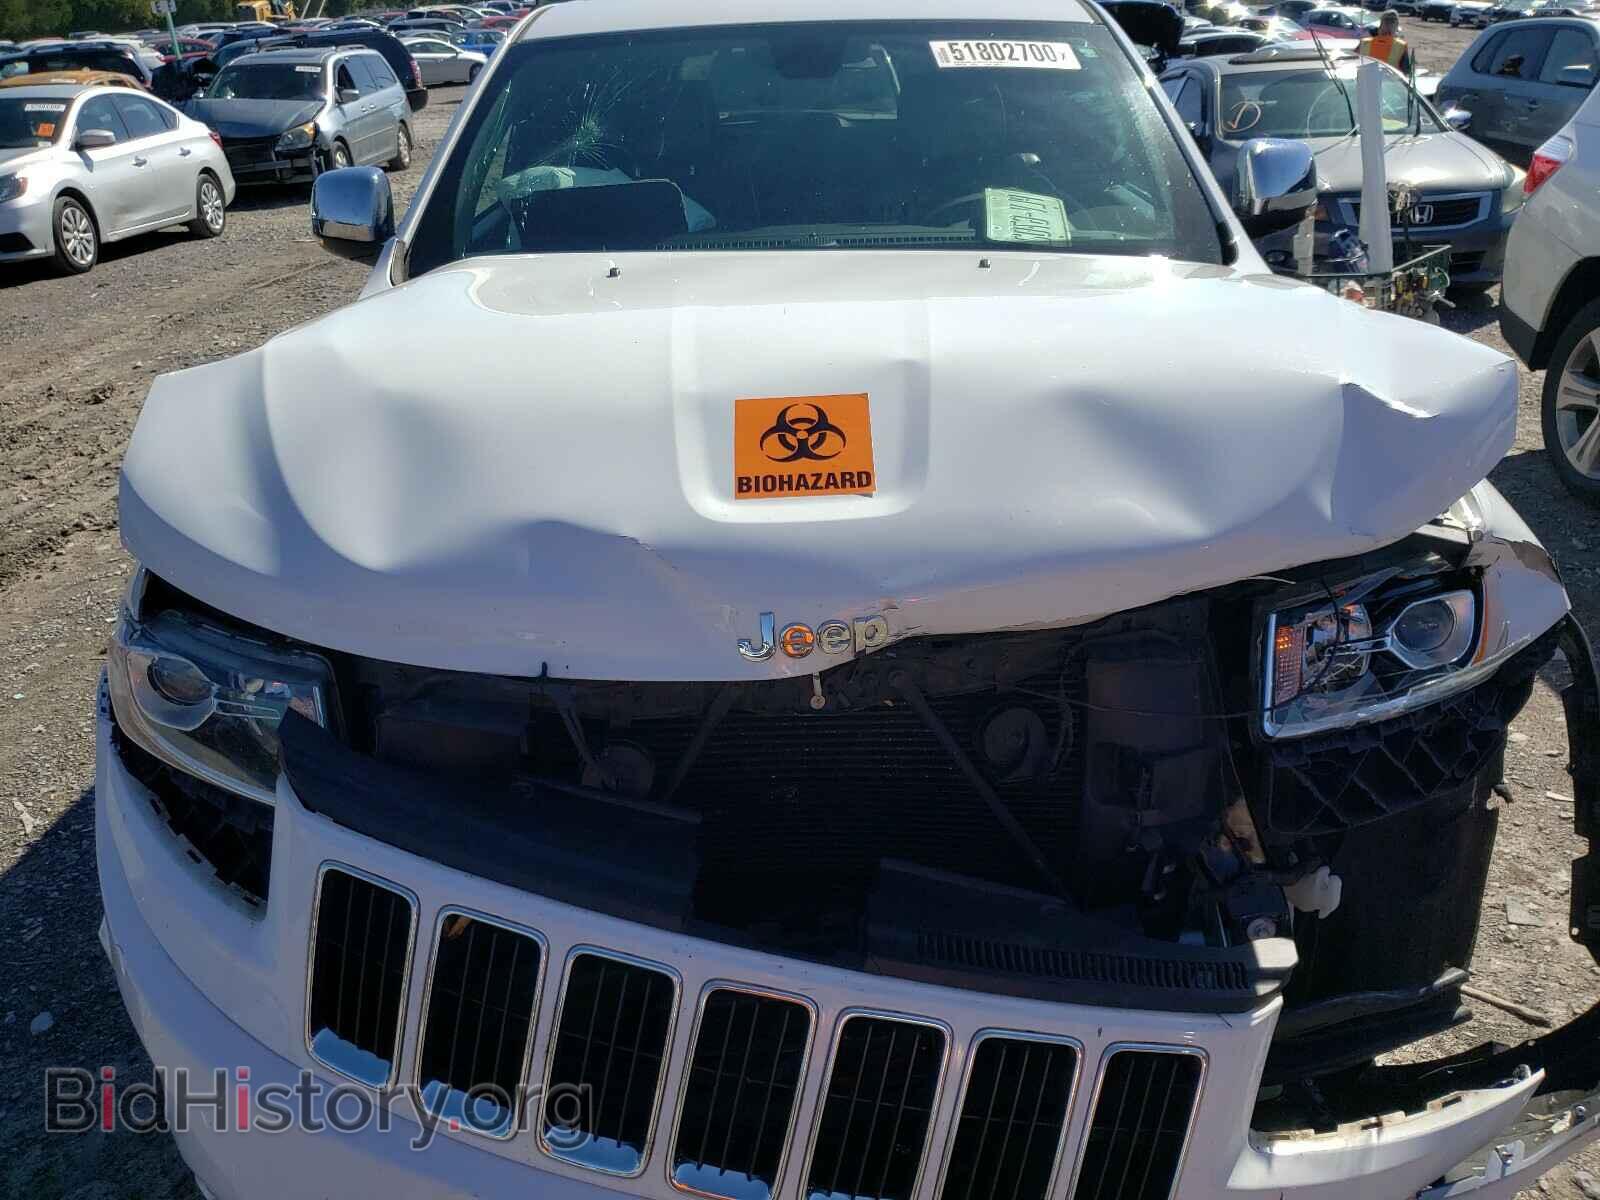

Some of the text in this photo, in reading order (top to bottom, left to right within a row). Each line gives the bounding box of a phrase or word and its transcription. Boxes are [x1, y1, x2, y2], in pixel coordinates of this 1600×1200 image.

[948, 42, 1057, 62] 51802700
[737, 471, 873, 494] BIOHAZARD
[737, 611, 889, 663] Jeep
